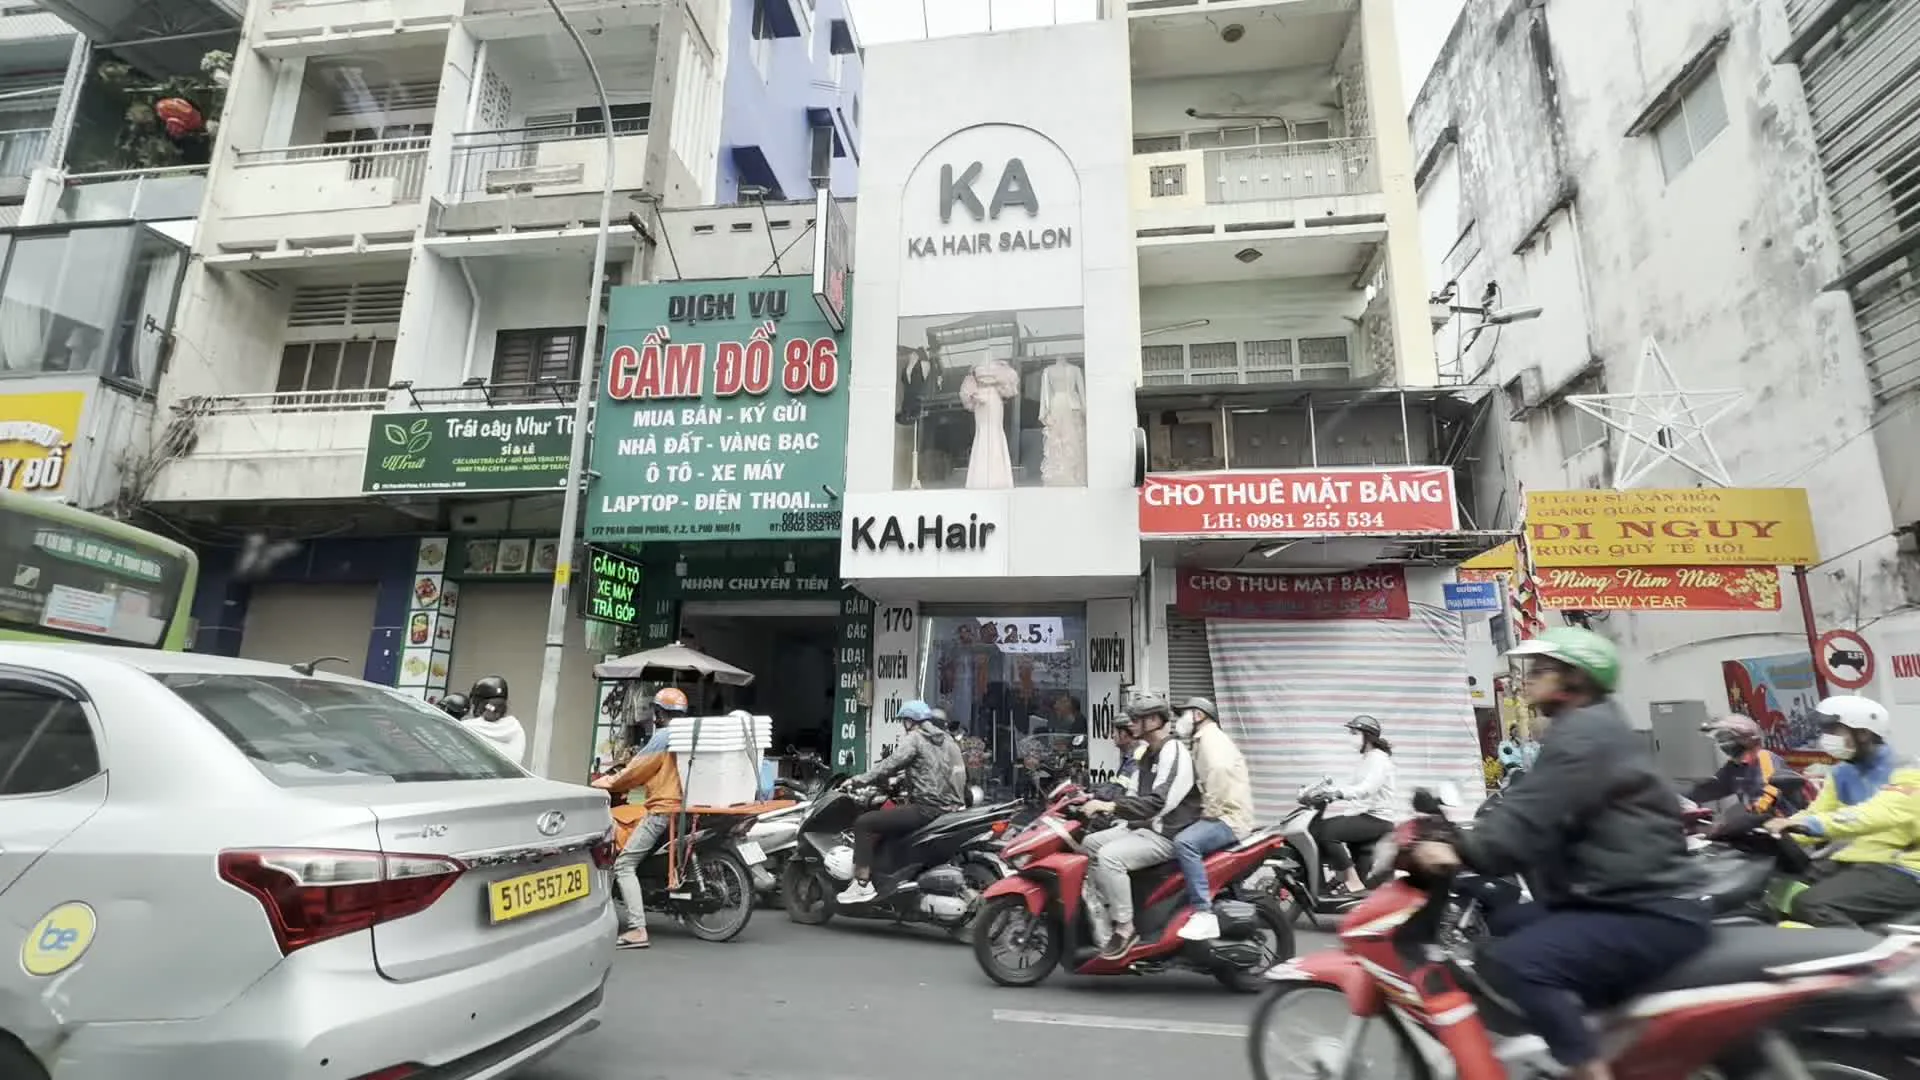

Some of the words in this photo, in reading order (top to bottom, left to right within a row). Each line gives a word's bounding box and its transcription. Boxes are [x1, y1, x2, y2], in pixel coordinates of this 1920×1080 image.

[940, 157, 1039, 222] KA
[908, 237, 937, 258] KA
[943, 233, 992, 255] HAIR
[999, 227, 1072, 251] SALON
[668, 292, 736, 326] DỊCH
[748, 289, 790, 321] VỤ
[608, 325, 706, 401] CẦM
[712, 320, 776, 399] ĐỒ
[783, 337, 838, 393] 86
[633, 408, 675, 427] MUA
[681, 403, 722, 425] BÁN
[740, 402, 766, 424] KÝ
[772, 400, 806, 422] GỬI
[446, 418, 478, 437] Trái
[481, 420, 512, 441] cây
[516, 416, 552, 436] Như
[618, 432, 657, 456] NHÀ
[664, 430, 704, 454] ĐẤT
[720, 432, 772, 452] VÀNG
[778, 433, 819, 455] BẠC
[646, 463, 660, 483] Ô
[667, 462, 693, 482] TÔ
[712, 464, 736, 481] XE
[743, 459, 785, 480] MÁY
[601, 494, 679, 513] LAPTOP
[695, 490, 741, 515] ĐIỆN
[1143, 483, 1205, 506] CHO
[1209, 478, 1285, 505] THUÊ
[1292, 476, 1353, 510] MẶT
[1360, 473, 1443, 503] BẰNG
[851, 513, 996, 552] KA.Hair
[1201, 514, 1241, 530] LH:
[1246, 512, 1295, 529] 0981
[1302, 512, 1341, 528] 255
[1347, 511, 1385, 528] 534
[1529, 522, 1597, 540] DI
[1616, 520, 1782, 540] NGUY
[594, 555, 616, 577] CẦM
[617, 561, 625, 579] Ô
[627, 566, 640, 584] TÔ
[1616, 568, 1672, 588] Năm
[1676, 568, 1723, 588] Mới
[598, 579, 611, 596] XE
[613, 583, 634, 602] MÁY
[1189, 575, 1232, 592] CHO
[593, 597, 613, 617] TRẢ
[615, 603, 636, 621] GÓP
[1591, 596, 1633, 609] NEW
[1637, 595, 1688, 608] YEAR
[883, 608, 913, 633] 170
[841, 720, 857, 740] CÓ
[501, 869, 583, 911] 51G-557.28
[39, 919, 79, 951] be
